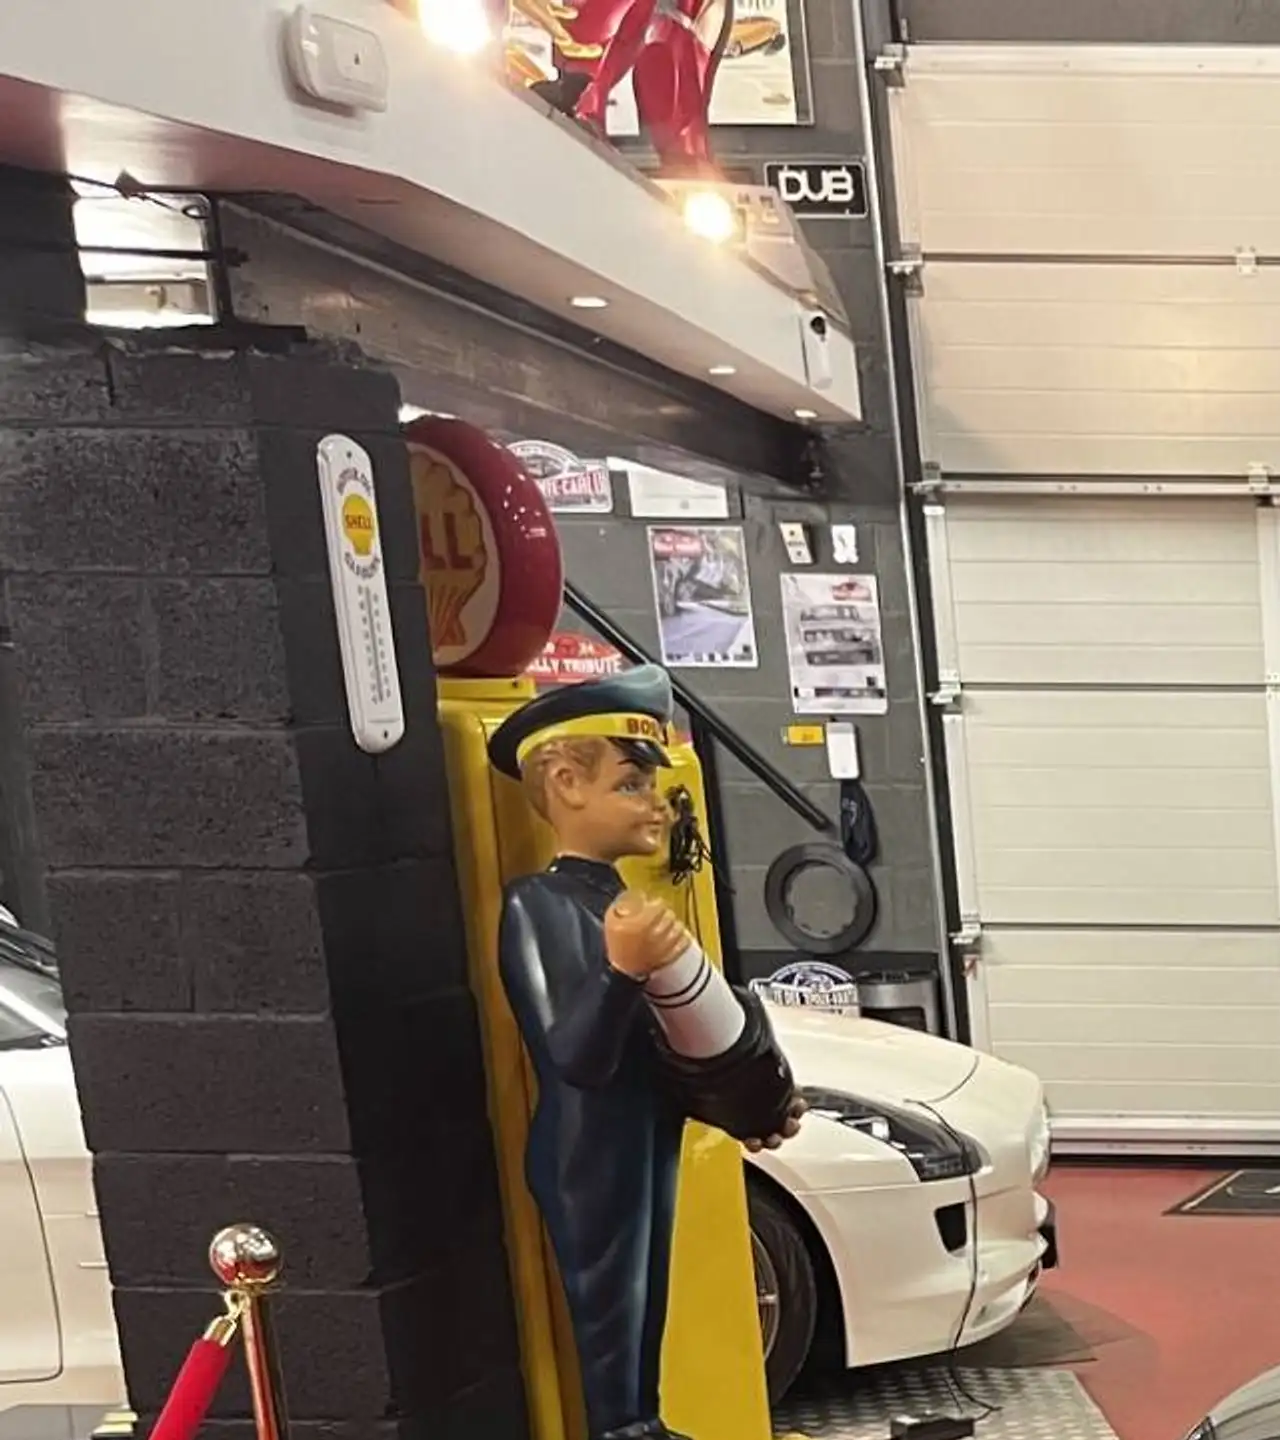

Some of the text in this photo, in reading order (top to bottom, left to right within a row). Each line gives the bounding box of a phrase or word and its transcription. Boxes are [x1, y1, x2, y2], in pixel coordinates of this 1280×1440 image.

[777, 164, 854, 202] DUB
[525, 657, 623, 677] ALLY TRIBUTE
